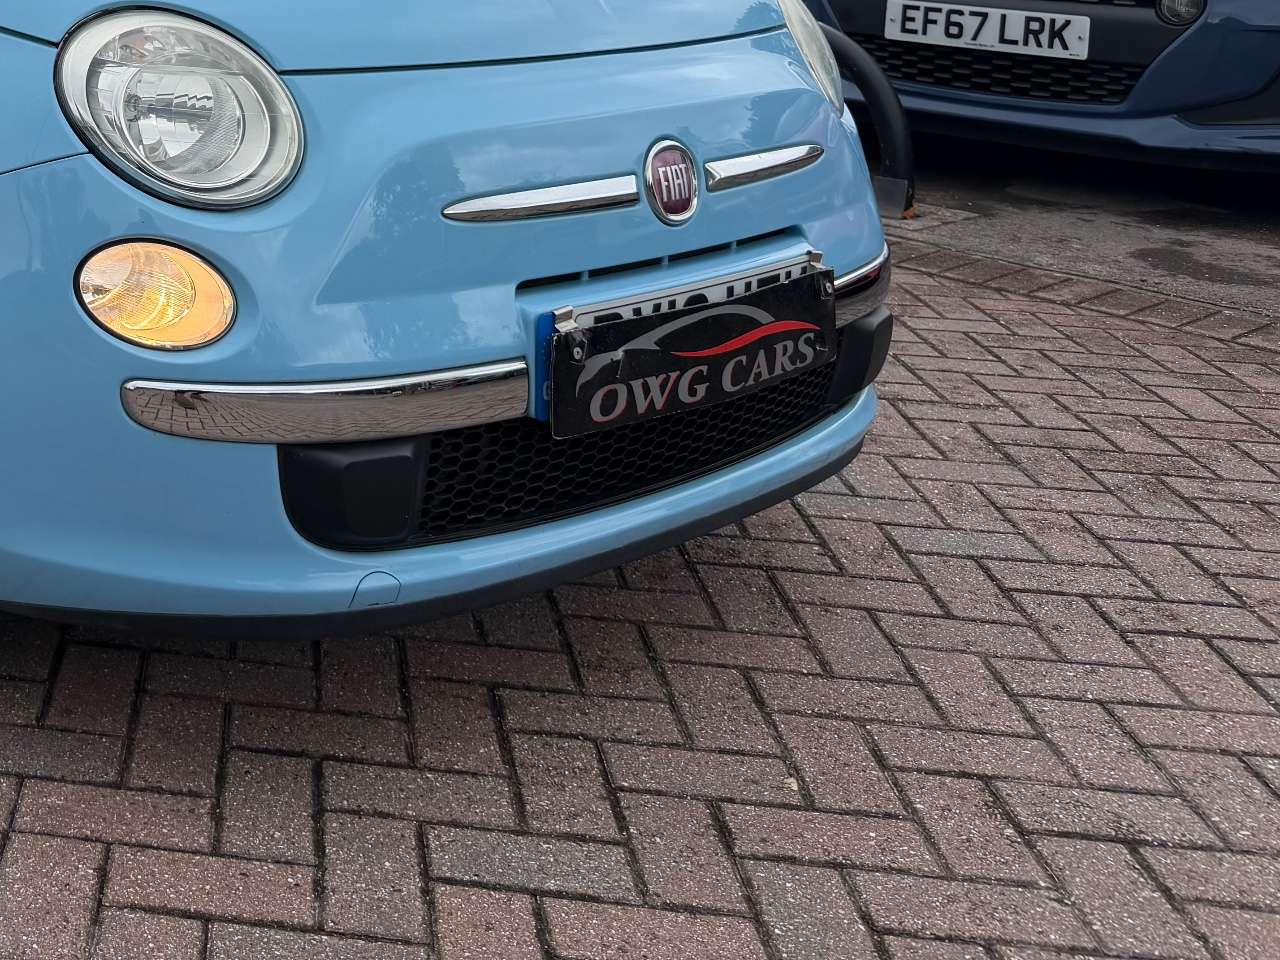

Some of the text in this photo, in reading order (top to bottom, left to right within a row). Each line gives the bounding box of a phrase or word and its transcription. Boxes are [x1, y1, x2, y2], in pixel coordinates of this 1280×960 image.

[900, 4, 1071, 51] EF67 LRK
[657, 162, 689, 202] FIAT
[589, 332, 816, 424] OWG CARS
